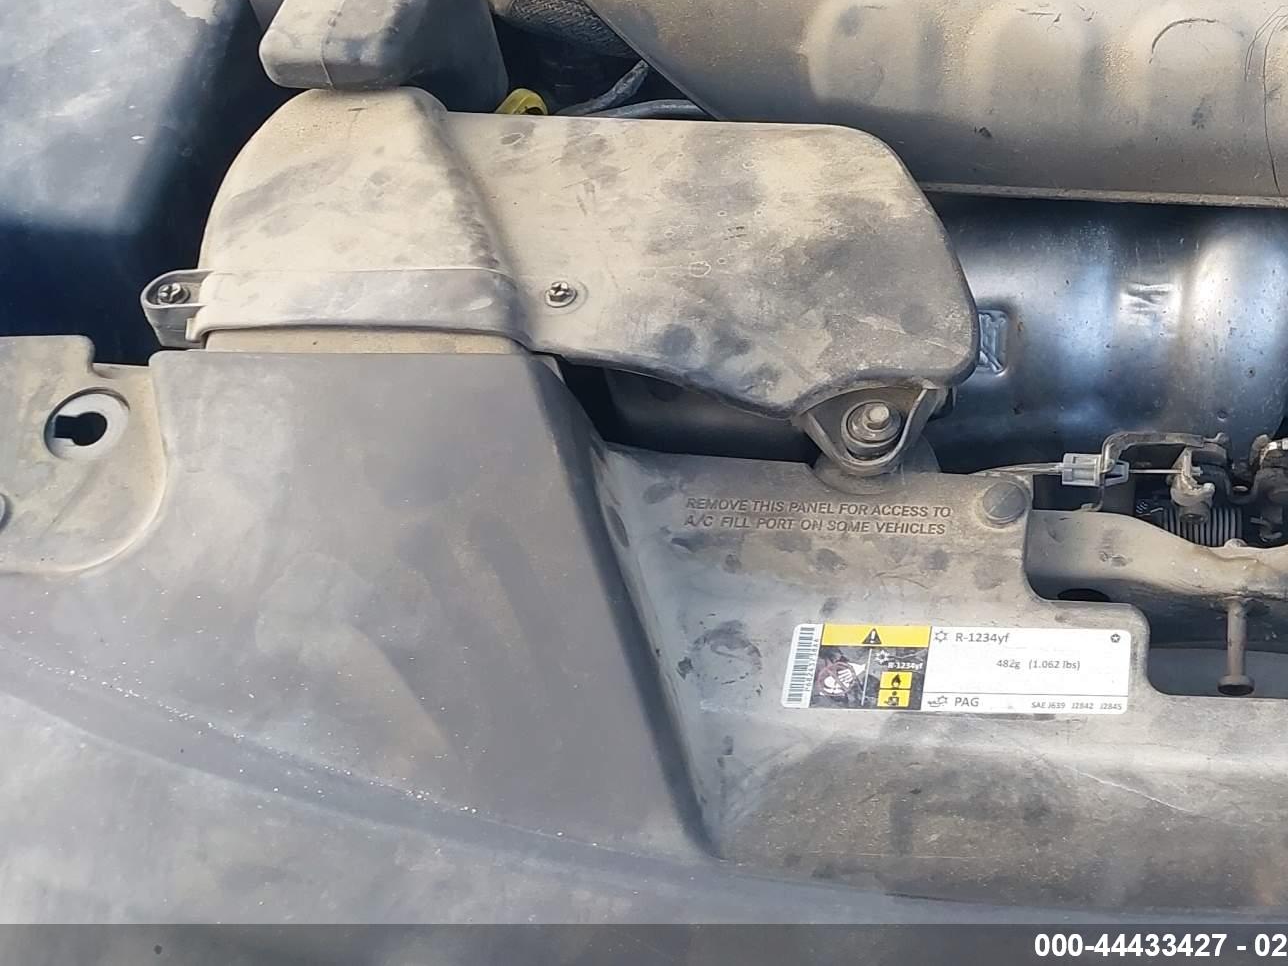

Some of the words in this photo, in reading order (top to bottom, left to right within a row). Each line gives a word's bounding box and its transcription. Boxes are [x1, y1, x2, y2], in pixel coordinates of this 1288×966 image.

[685, 497, 748, 511] REMOVE
[751, 500, 784, 513] THIS
[788, 501, 835, 514] PANEL
[838, 503, 868, 516] FOR
[871, 504, 928, 517] ACCESS
[933, 505, 951, 518] TO
[684, 514, 713, 527] A/C
[720, 516, 750, 528] FILL
[756, 517, 794, 530] PORT
[800, 518, 823, 531] ON
[826, 520, 869, 532] SOME
[875, 521, 946, 535] VEHICLES
[955, 632, 1010, 645] R-1234yf
[887, 661, 923, 670] R-1234yf
[996, 659, 1021, 670] 482g
[1028, 659, 1060, 670] (1.062
[1062, 659, 1081, 671] lbs)
[954, 697, 980, 707] PAG
